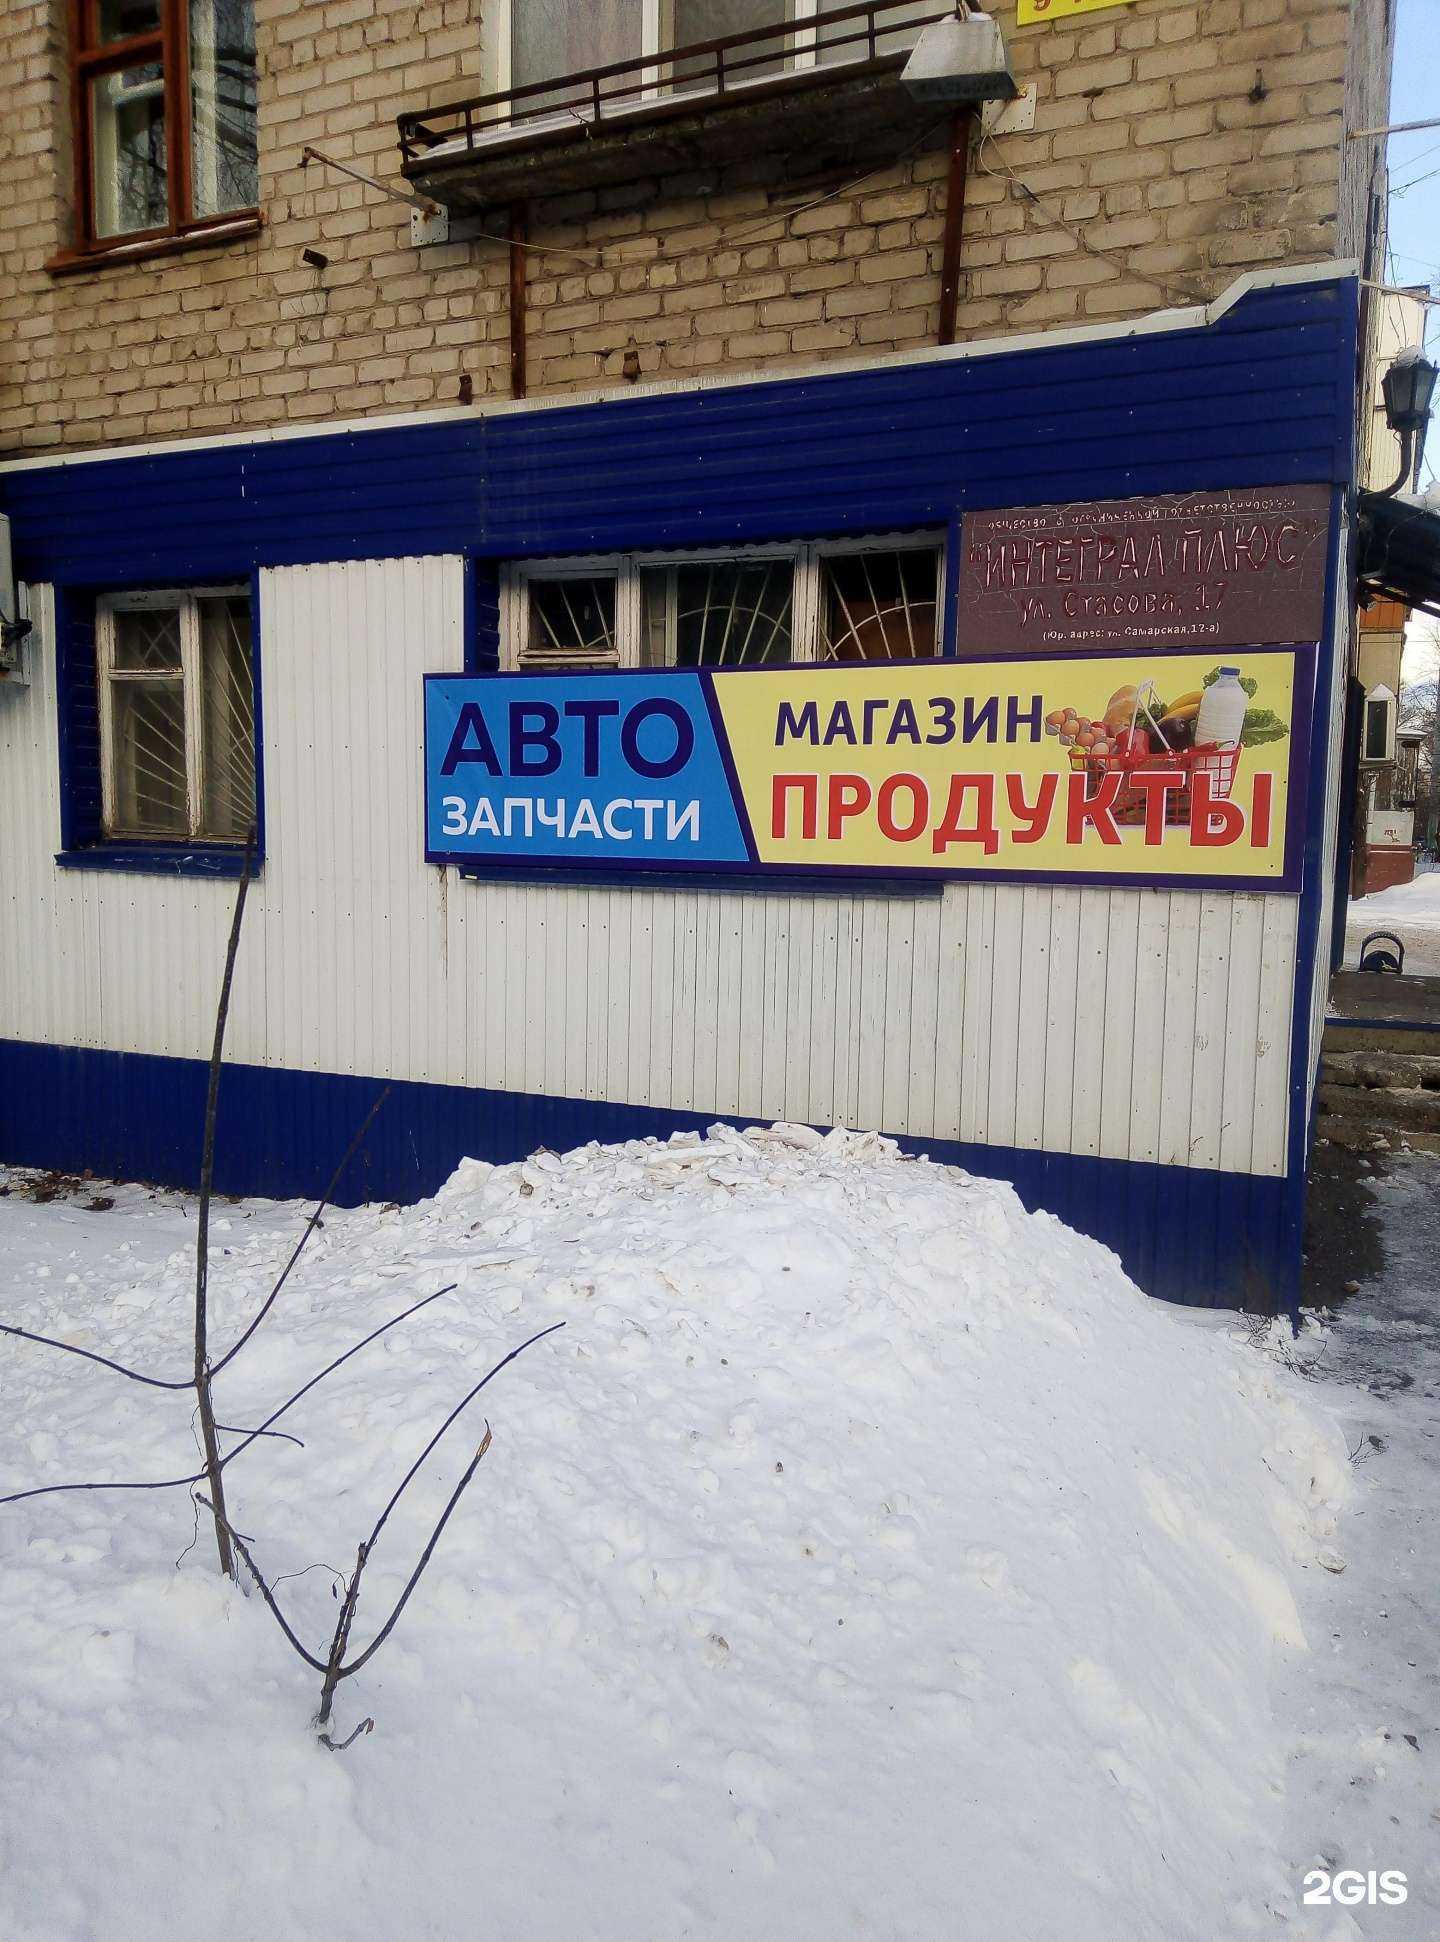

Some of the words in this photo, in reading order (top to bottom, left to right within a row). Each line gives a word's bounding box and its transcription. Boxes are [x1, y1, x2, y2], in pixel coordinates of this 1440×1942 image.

[1193, 581, 1228, 611] 17
[439, 697, 696, 779] АВТО
[774, 695, 1044, 746] МАГАЗИН
[442, 795, 701, 842] ЗАПЧАСТИ
[770, 772, 1274, 856] ПРОДУКТЫ
